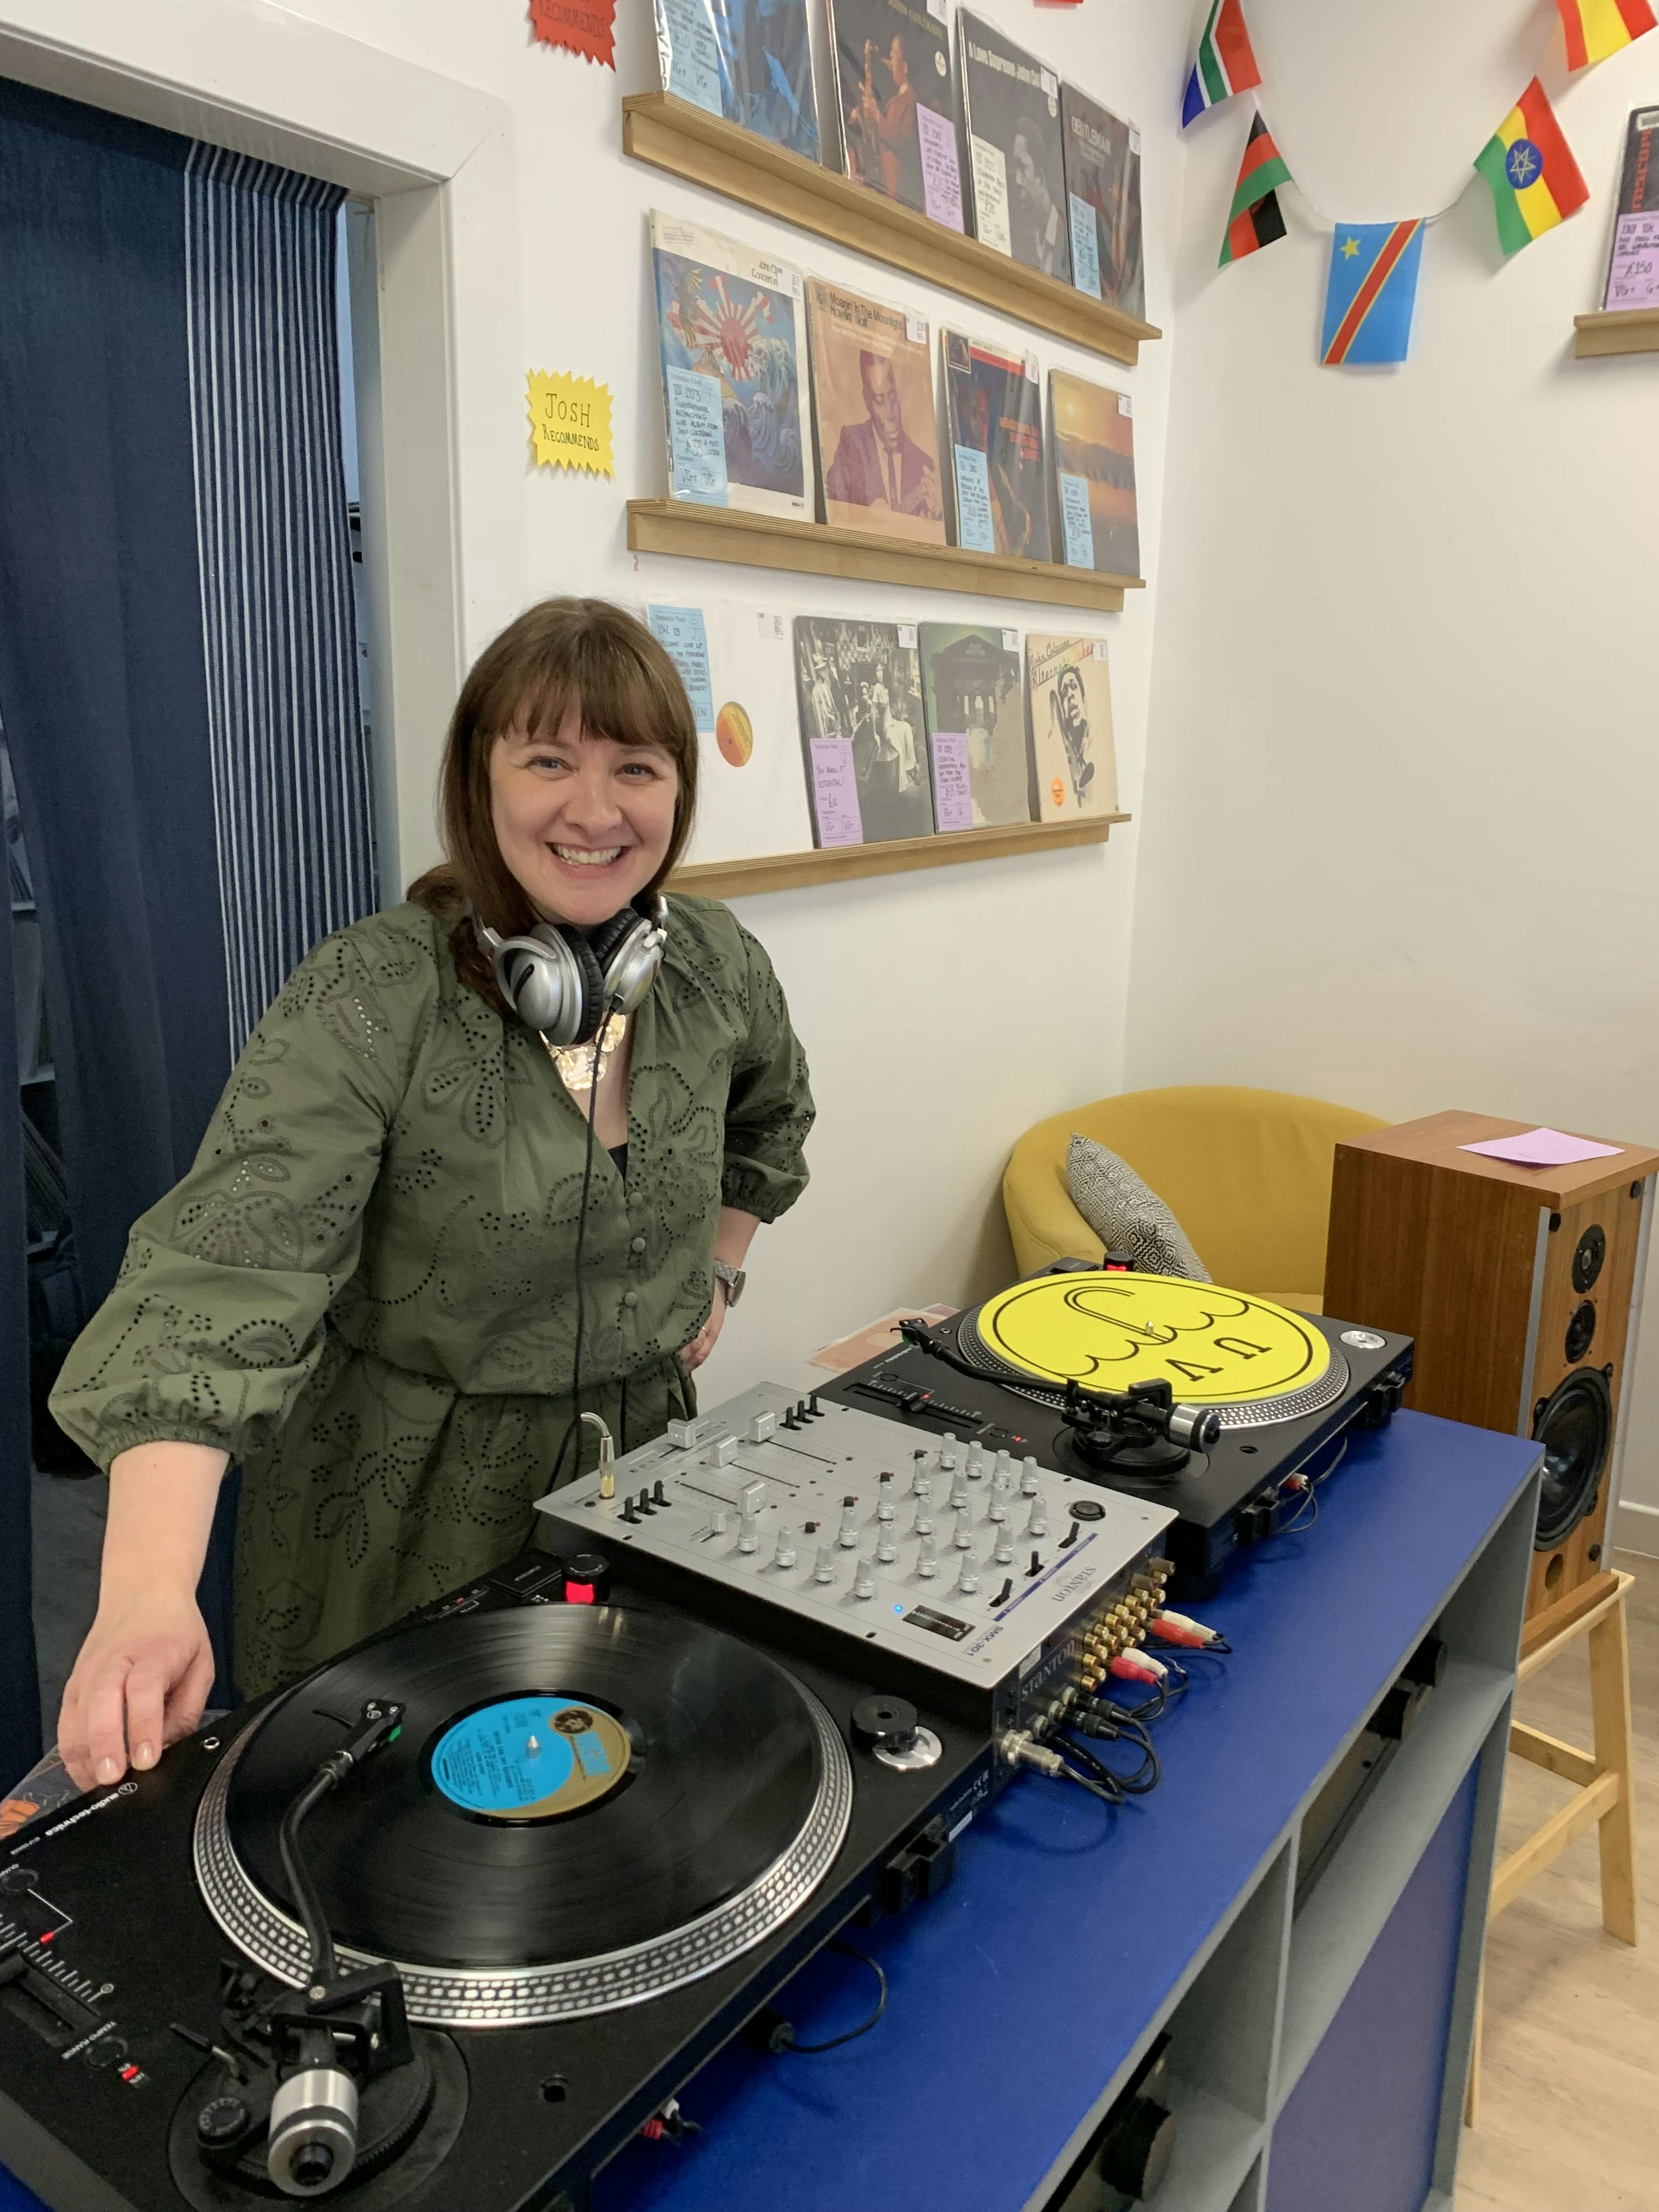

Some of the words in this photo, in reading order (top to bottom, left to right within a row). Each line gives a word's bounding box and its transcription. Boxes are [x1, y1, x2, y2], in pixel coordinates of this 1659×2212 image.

[859, 304, 873, 320] The
[545, 392, 591, 428] JOSH
[541, 423, 600, 452] RECOMMENDS
[1213, 1337, 1273, 1359] U
[1165, 1357, 1224, 1383] V
[45, 1792, 119, 1836] audio-technica
[88, 2021, 117, 2041] TEMPO
[60, 2038, 90, 2060] RANGE
